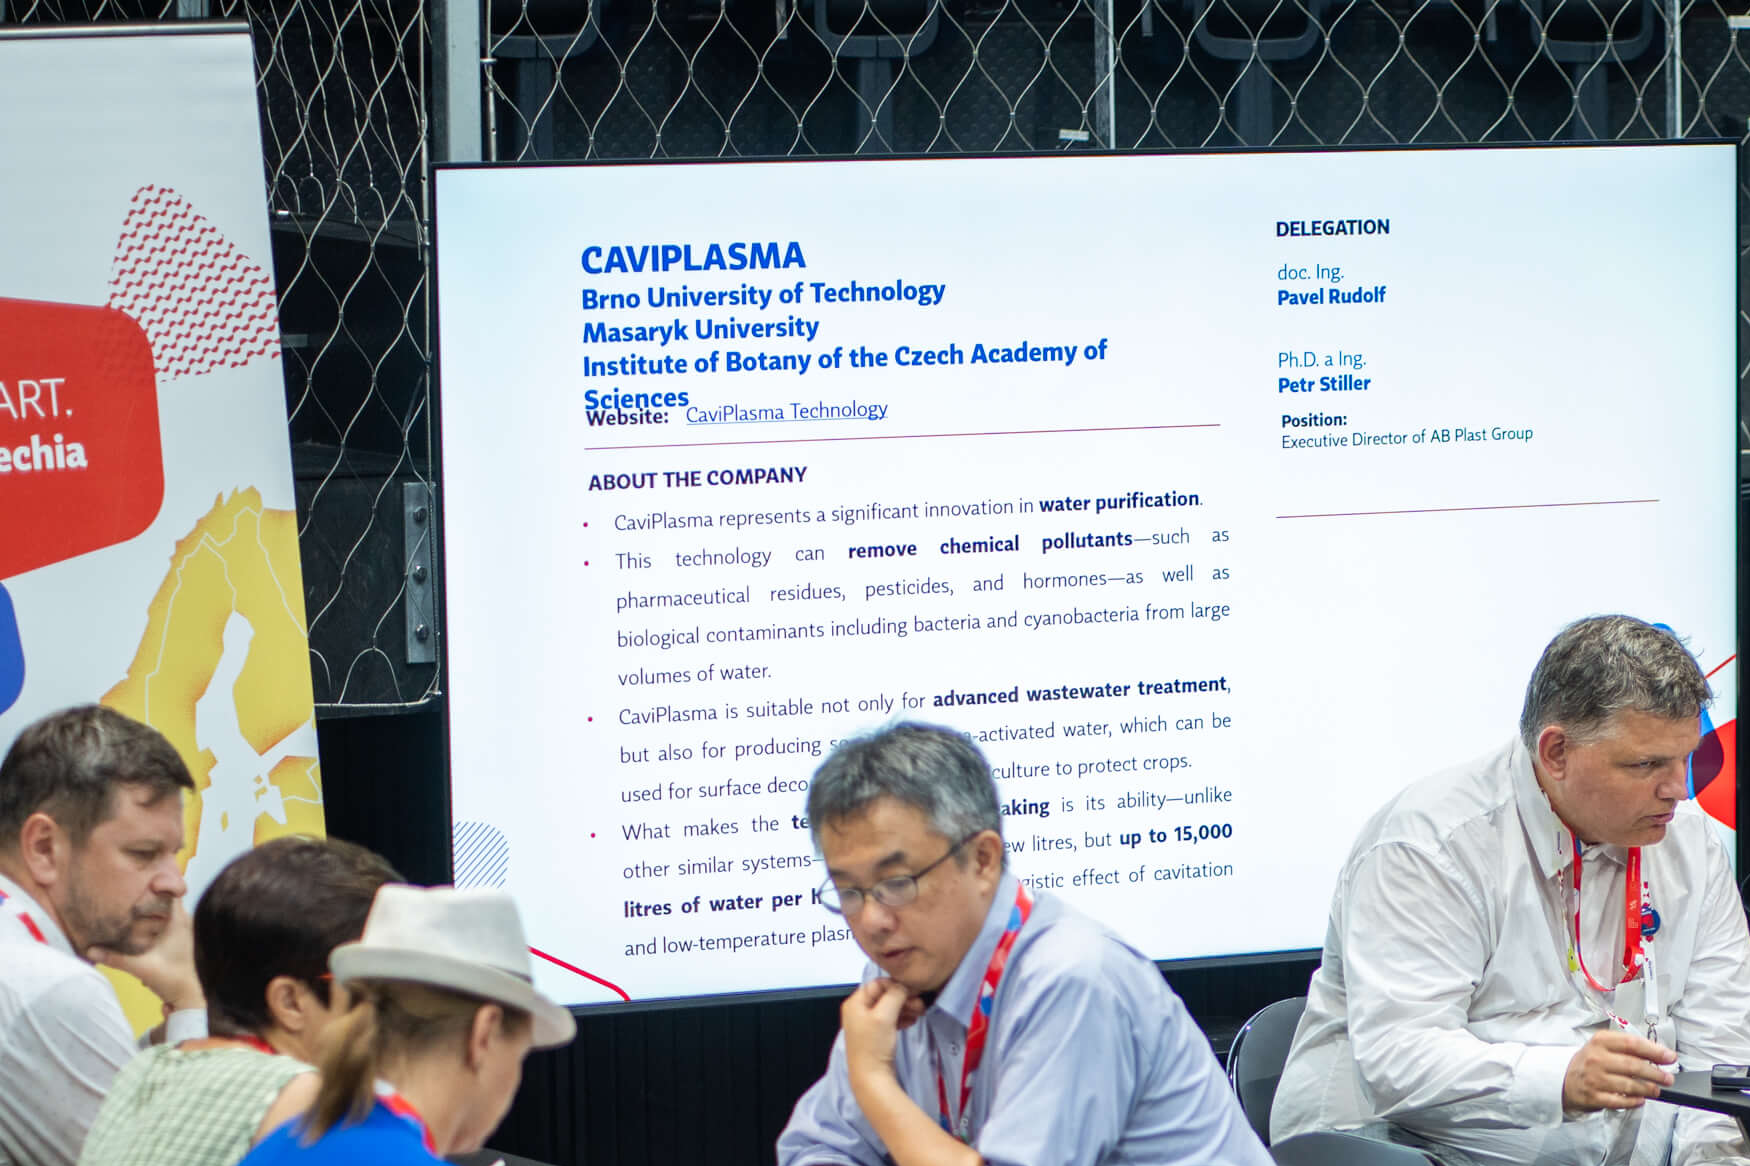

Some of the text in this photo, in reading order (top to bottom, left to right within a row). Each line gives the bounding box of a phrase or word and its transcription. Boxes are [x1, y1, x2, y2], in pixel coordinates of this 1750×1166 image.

[1276, 218, 1390, 239] DELEGATION
[581, 241, 807, 275] CAVIPLASMA
[1277, 264, 1344, 283] doc. Ing.
[582, 278, 946, 311] Brno University of Technology
[1278, 285, 1387, 306] Pavel Rudolf
[583, 315, 820, 347] Masaryk University
[584, 338, 1108, 377] Institute of Botany of the Czech Academy of
[1278, 350, 1366, 370] Ph.D. a Ing.
[584, 387, 689, 410] Sciences
[1278, 374, 1371, 393] Petr Stiller
[586, 400, 888, 426] Website: CaviPlasma Technology
[1281, 412, 1347, 428] Position:
[1282, 427, 1533, 448] Executive Director of AB Plast Group
[588, 466, 807, 491] ABOUT THE COMPANY
[615, 490, 1203, 531] CaviPlasma represents a significant innovation in water purification.
[616, 552, 651, 569] This
[676, 546, 771, 568] technology
[796, 549, 824, 561] can
[849, 544, 917, 559] remove
[940, 534, 1019, 554] chemical
[1212, 531, 1229, 542] as
[617, 585, 749, 614] pharmaceutical
[771, 582, 845, 601] residues,
[866, 577, 953, 601] pesticides,
[973, 573, 1003, 591] and
[1162, 564, 1193, 582] well
[1212, 568, 1230, 580] as
[618, 601, 1230, 650] biological contaminants including bacteria and cyanobacteria from large
[618, 664, 771, 686] volumes of water.
[619, 676, 1231, 724] CaviPlasma is suitable not only for advanced wastewater treatment,
[621, 746, 649, 763] but
[658, 744, 692, 761] also
[702, 741, 726, 759] for
[736, 737, 821, 761] producing
[1063, 722, 1112, 738] water,
[1120, 715, 1167, 734] which
[1176, 718, 1203, 730] can
[1212, 712, 1231, 728] be
[622, 784, 661, 802] used
[668, 782, 693, 800] for
[699, 778, 761, 797] surface
[991, 761, 1050, 780] culture
[1056, 762, 1072, 775] to
[1078, 757, 1137, 779] protect
[1143, 757, 1192, 773] crops.
[622, 822, 671, 840] What
[684, 818, 738, 837] makes
[752, 815, 779, 832] the
[1062, 797, 1074, 812] is
[1086, 795, 1105, 811] its
[623, 860, 670, 879] other
[678, 856, 734, 875] similar
[1033, 835, 1077, 852] litres,
[1085, 832, 1111, 848] but
[1120, 833, 1141, 849] up
[1148, 828, 1167, 843] to
[1174, 823, 1232, 845] 15,000
[624, 900, 672, 918] litres
[681, 896, 701, 913] of
[709, 895, 763, 912] water
[772, 894, 803, 912] per
[1073, 868, 1120, 886] effect
[1129, 865, 1145, 882] of
[1154, 861, 1232, 880] cavitation
[625, 936, 656, 956] and
[663, 931, 806, 953] low-temperature
